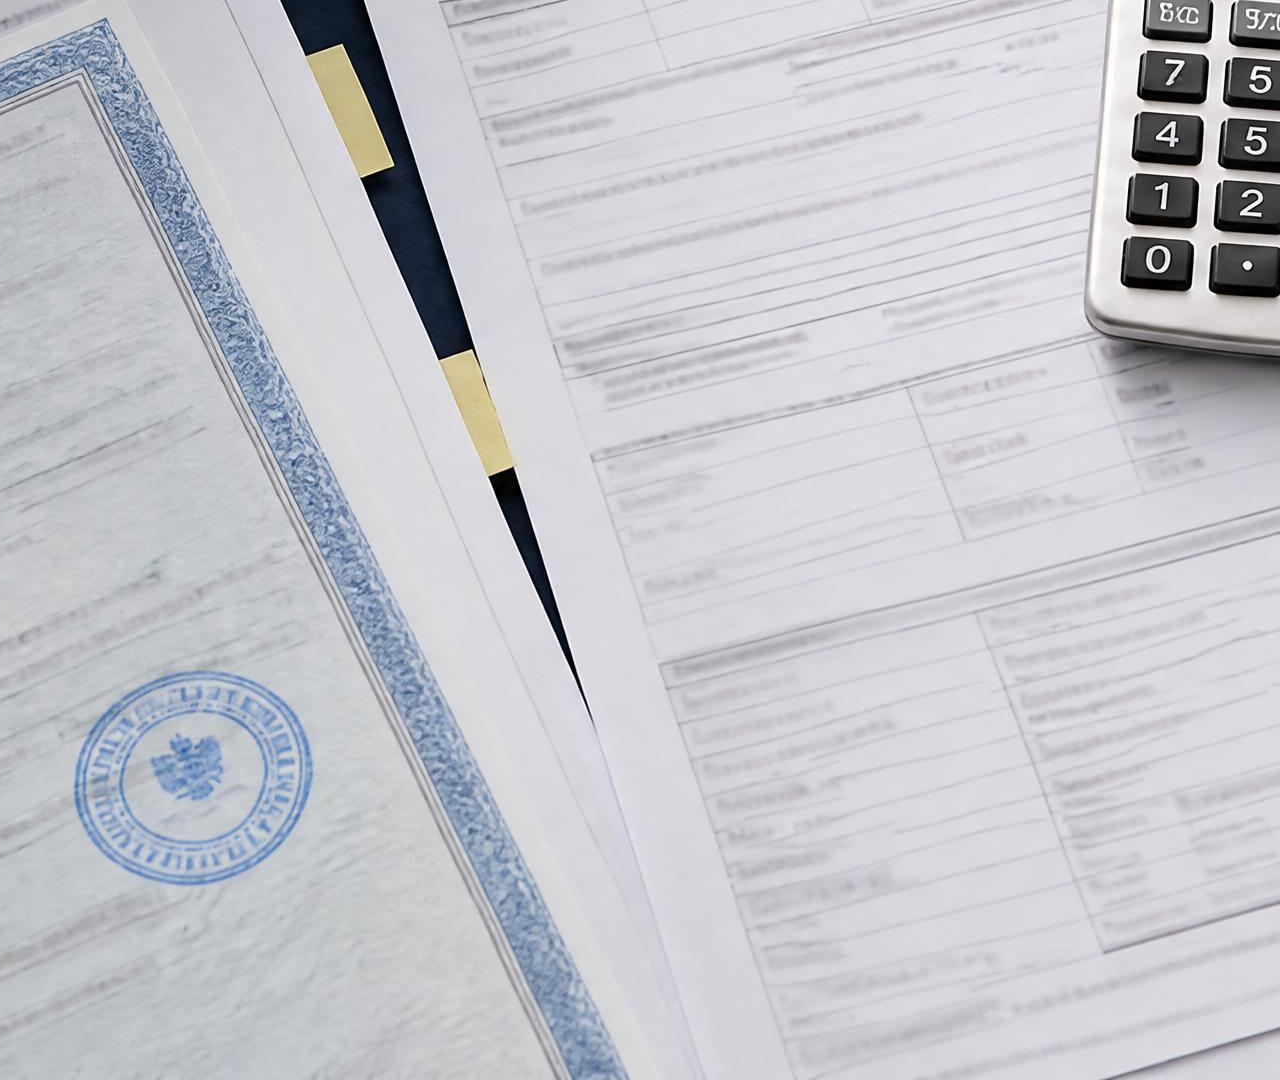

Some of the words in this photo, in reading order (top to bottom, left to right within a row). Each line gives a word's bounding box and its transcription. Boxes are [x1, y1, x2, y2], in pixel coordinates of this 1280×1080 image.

[1164, 58, 1186, 86] 7
[1248, 65, 1272, 94] 5
[1155, 120, 1179, 148] 4
[1243, 126, 1268, 156] 5
[1154, 182, 1169, 210] 1
[1239, 189, 1264, 218] 2
[1145, 245, 1171, 274] 0
